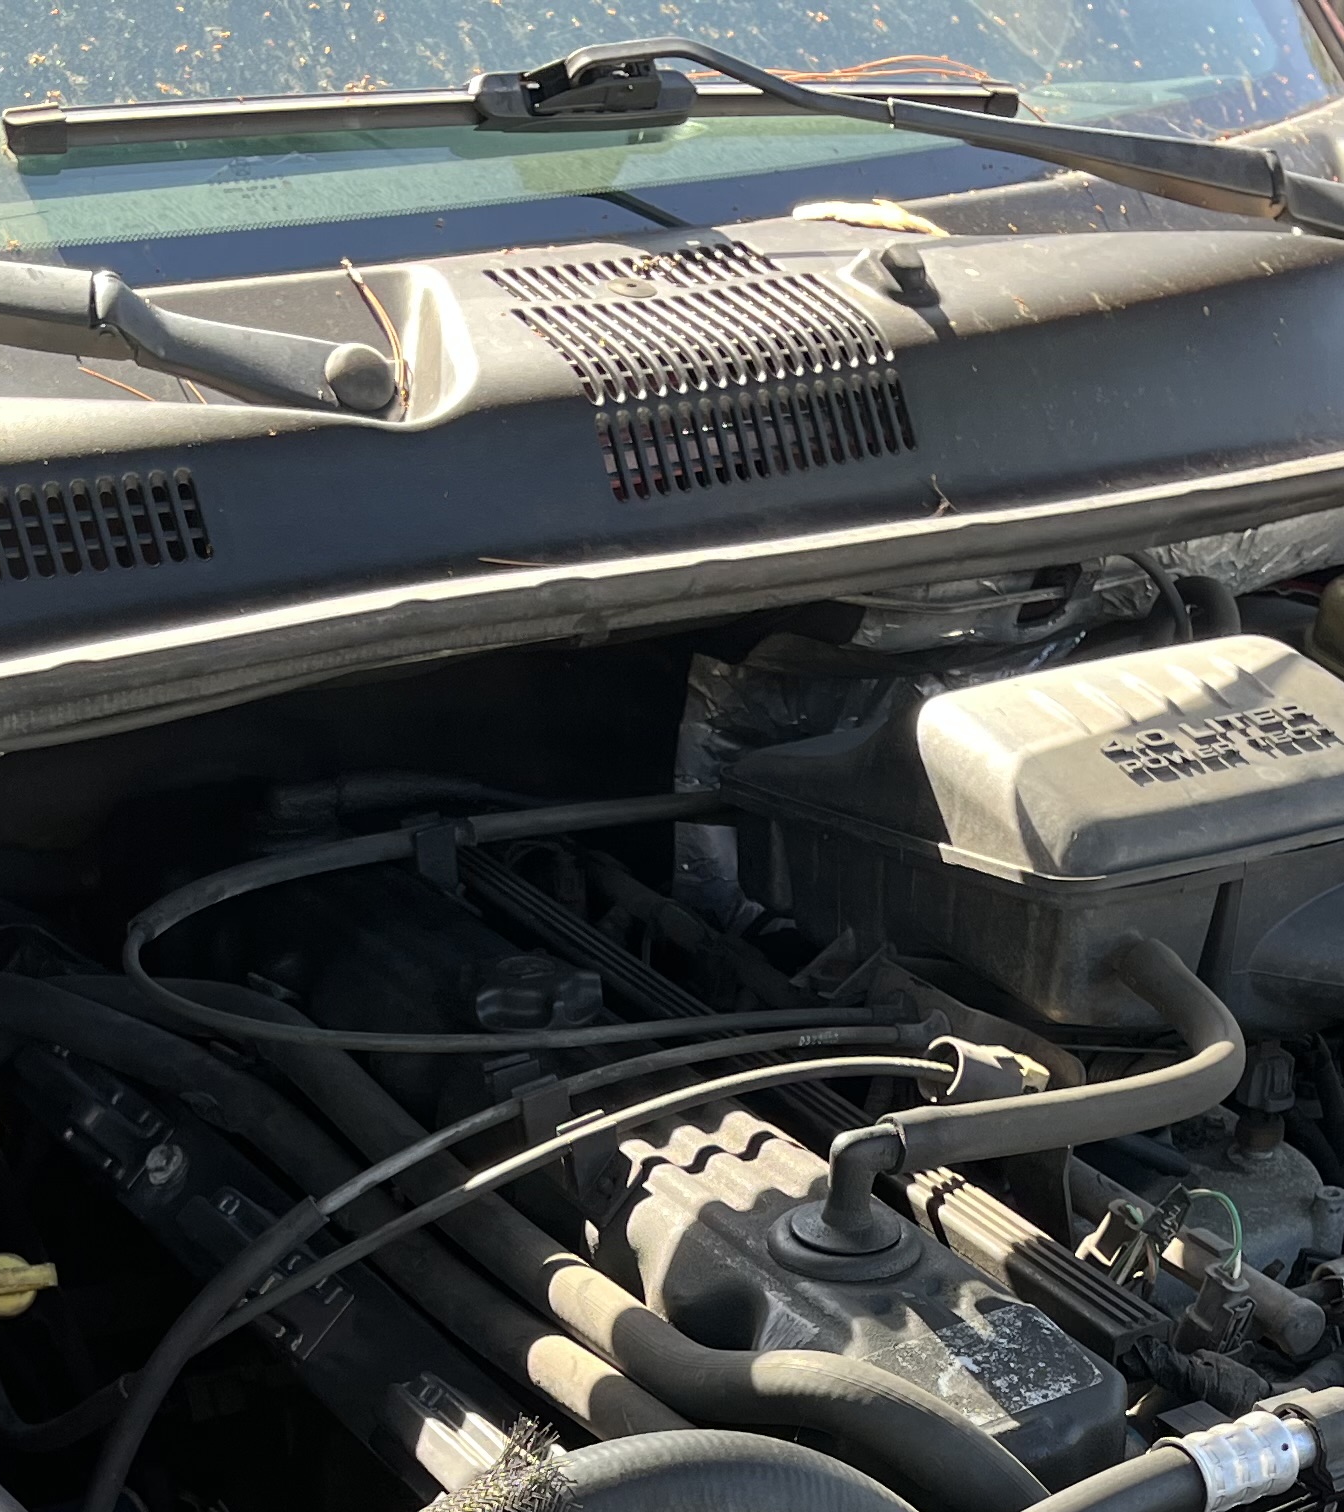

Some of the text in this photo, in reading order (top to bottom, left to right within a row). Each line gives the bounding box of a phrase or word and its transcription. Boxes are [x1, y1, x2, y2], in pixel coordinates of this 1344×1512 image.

[1179, 705, 1316, 738] LITER
[1119, 722, 1336, 774] POWER TECH
